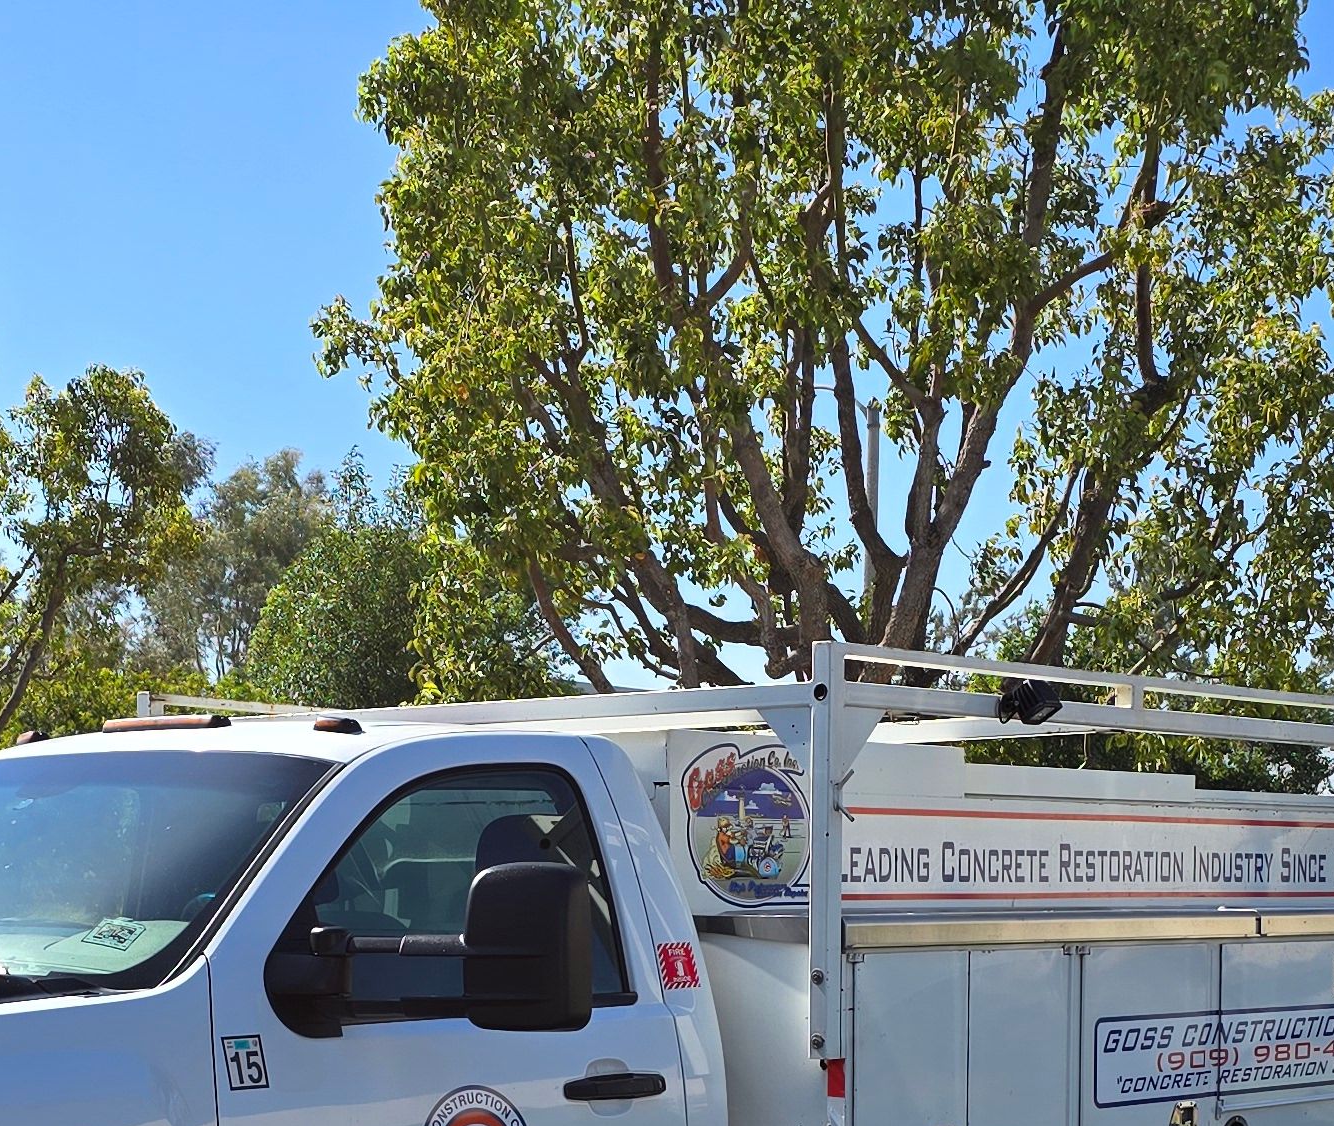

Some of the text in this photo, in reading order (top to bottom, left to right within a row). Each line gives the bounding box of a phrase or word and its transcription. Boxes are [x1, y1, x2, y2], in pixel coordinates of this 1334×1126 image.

[941, 841, 1049, 883] CONCRETE
[1059, 843, 1184, 883] RESTORATION
[1192, 845, 1274, 883] INDUSTRY
[1280, 847, 1327, 883] SINCE
[668, 948, 686, 956] FIRE
[1103, 1025, 1175, 1053] GOSS
[230, 1051, 263, 1084] 15
[1157, 1047, 1239, 1072] (909)
[1217, 1060, 1328, 1084] RESTORATION
